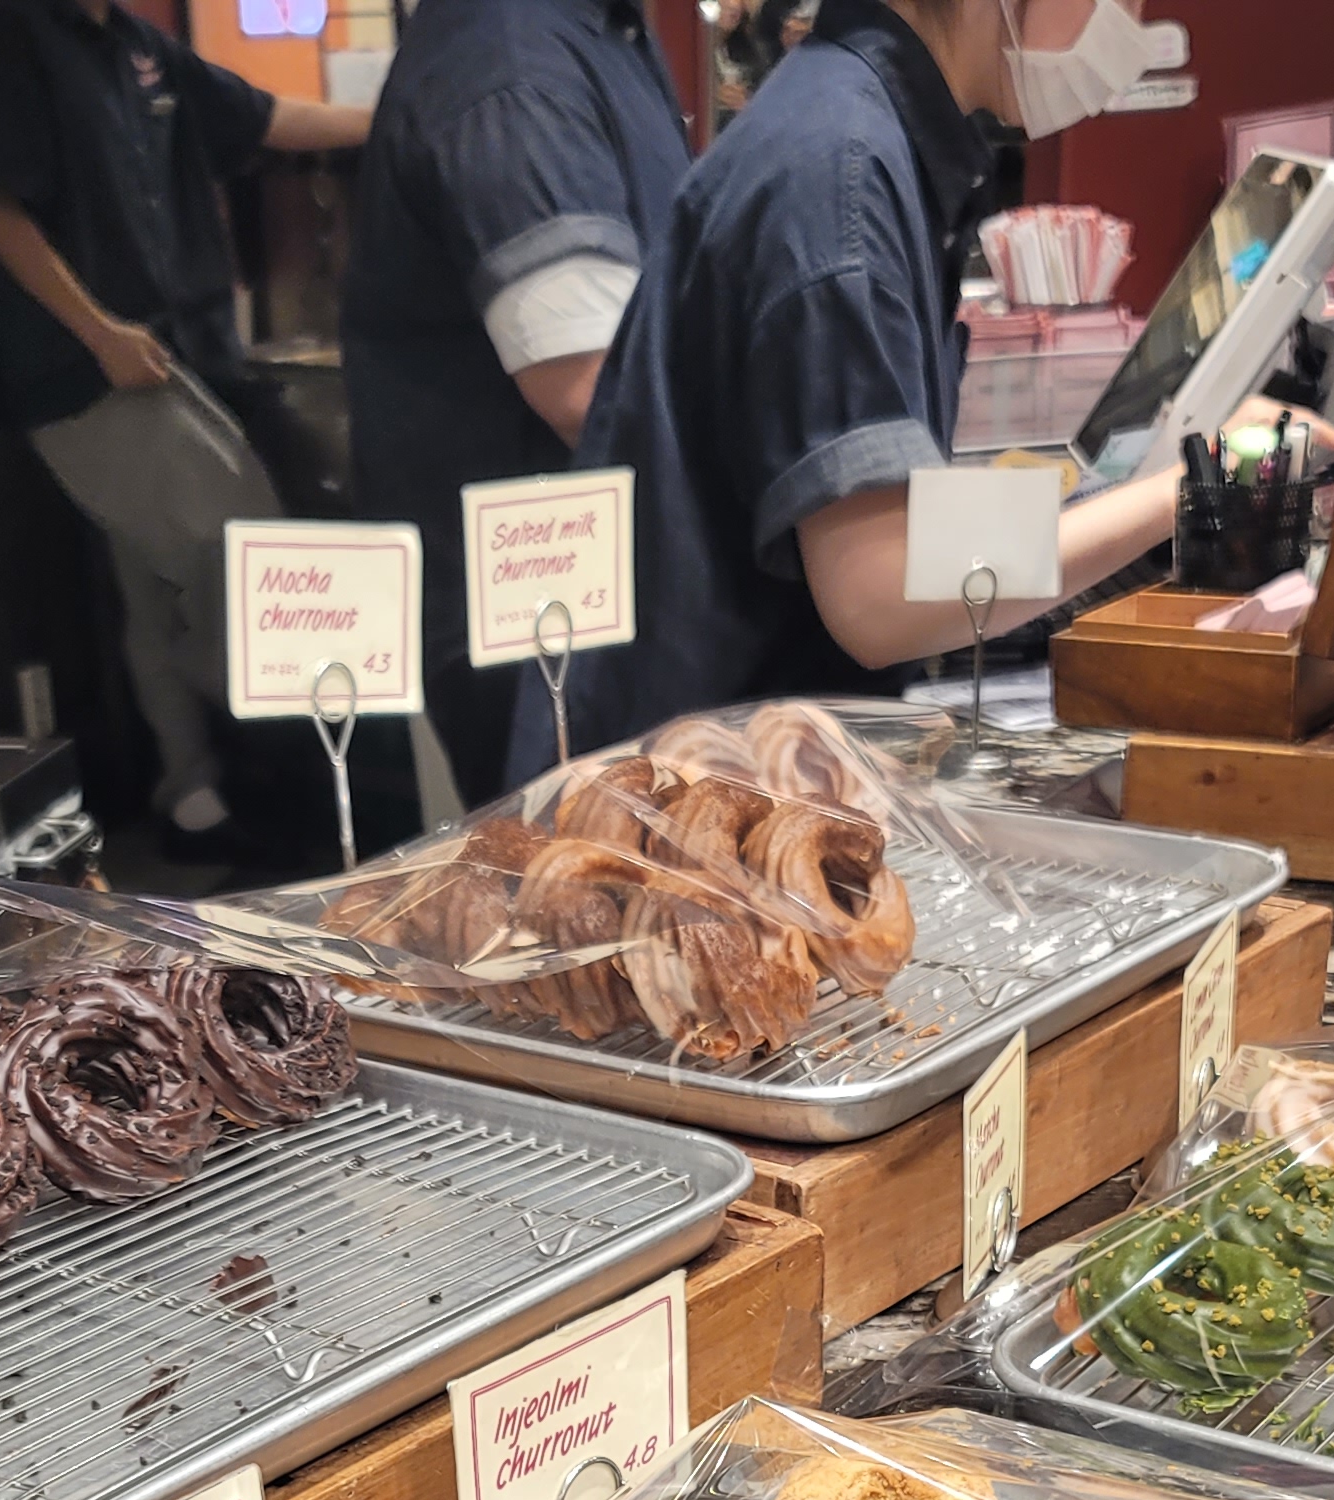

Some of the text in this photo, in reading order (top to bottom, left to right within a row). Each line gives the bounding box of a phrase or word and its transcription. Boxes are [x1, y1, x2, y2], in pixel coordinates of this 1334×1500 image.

[491, 511, 597, 551] Salted milk
[257, 566, 333, 594] Mocha
[492, 551, 577, 585] churronut
[258, 602, 359, 632] churronut
[494, 1365, 592, 1450] Injeolmi
[496, 1401, 617, 1490] churronut
[623, 1435, 658, 1472] 4.8
